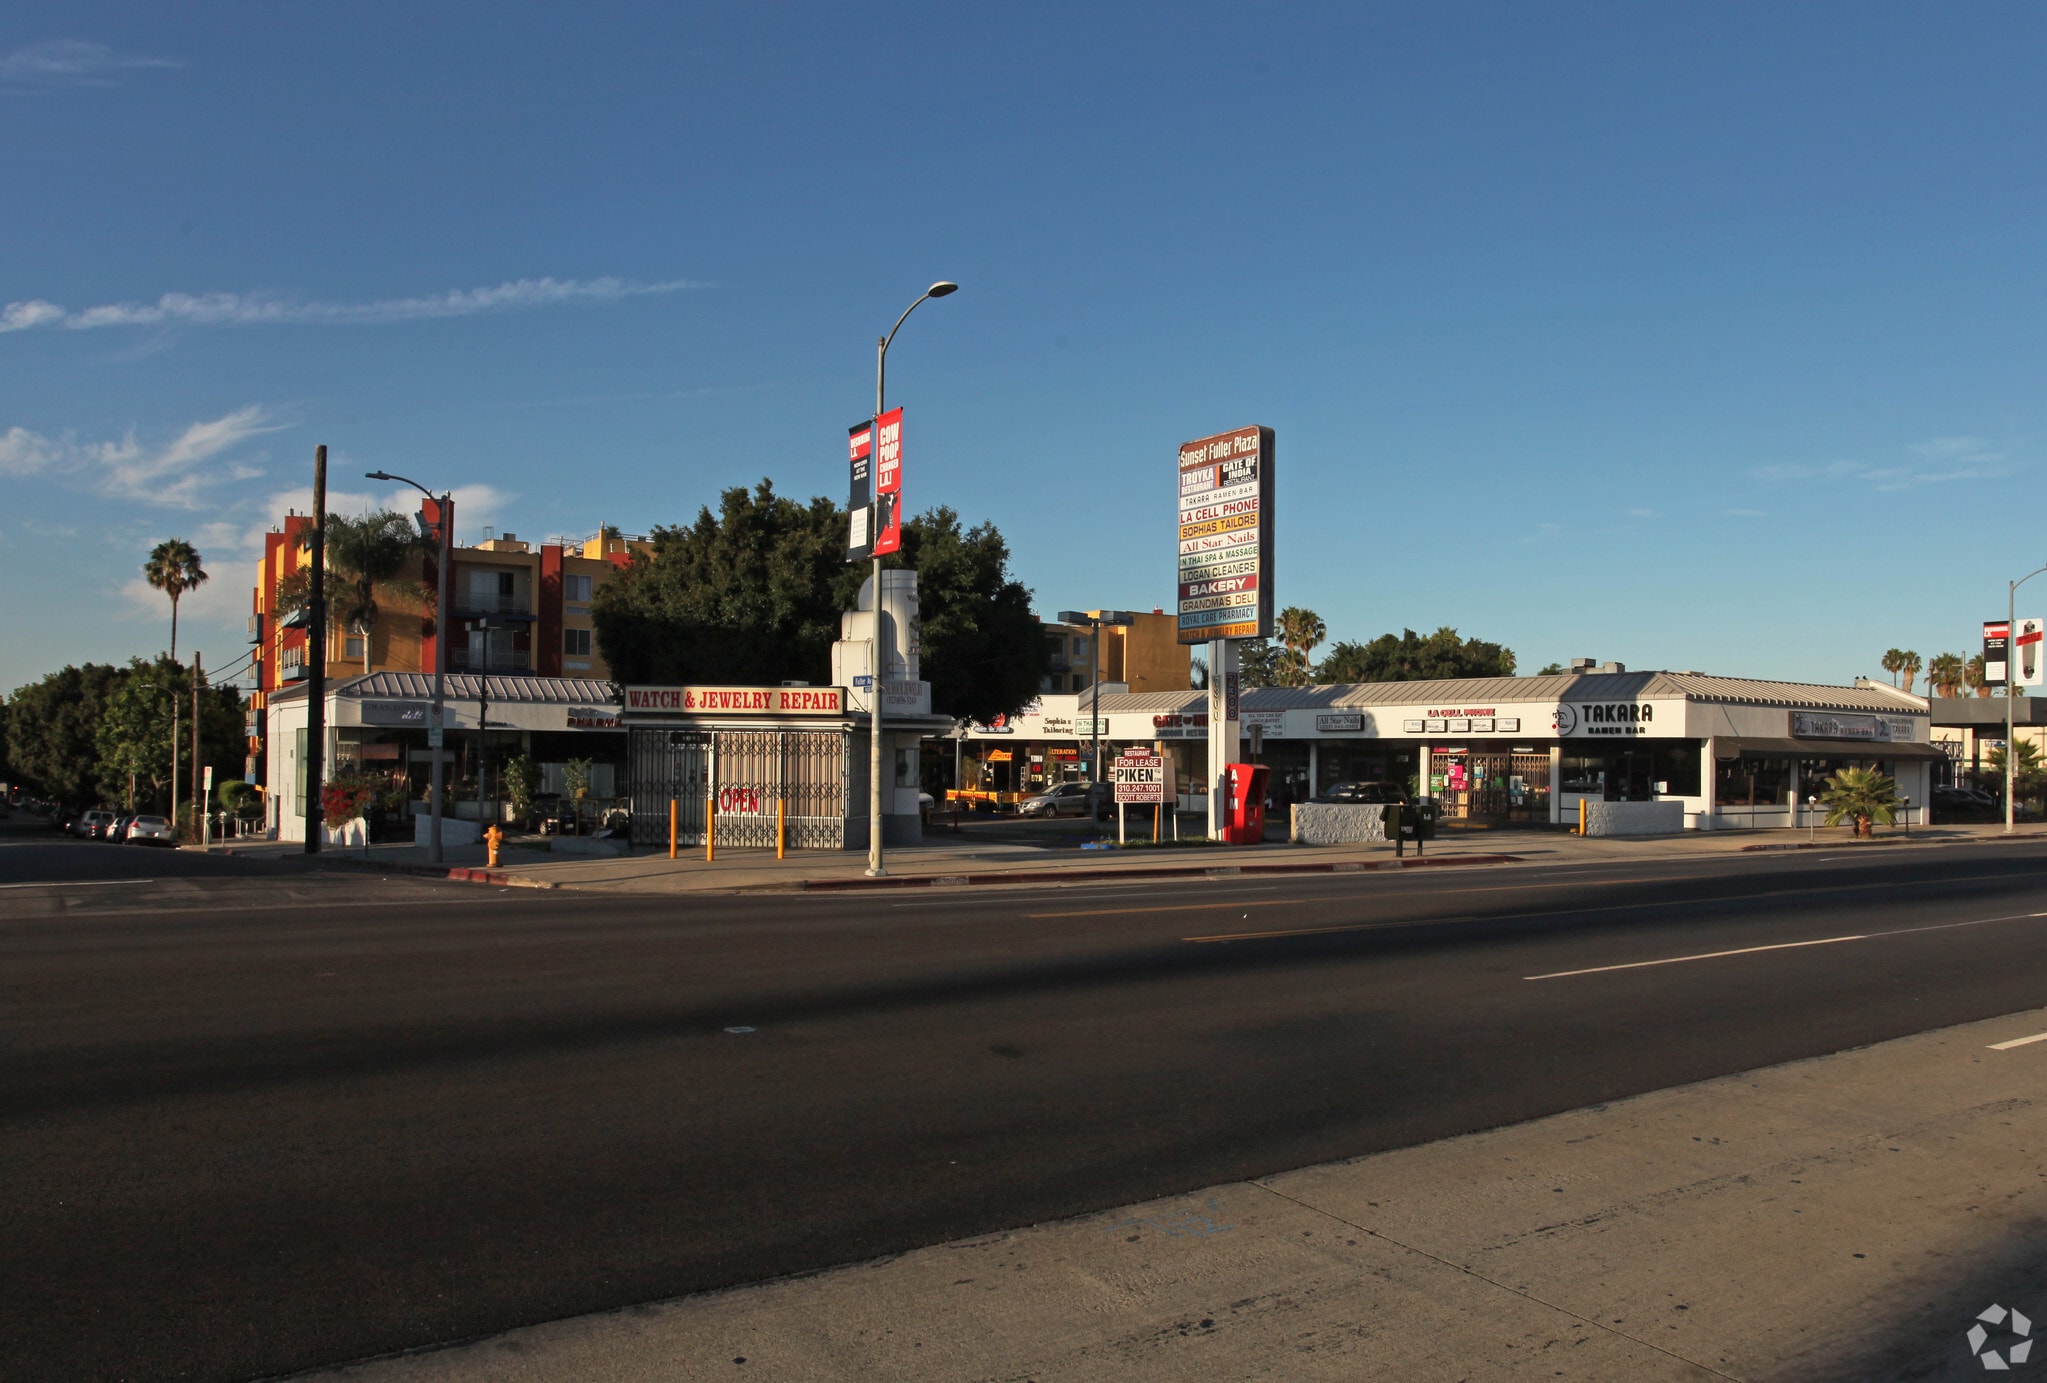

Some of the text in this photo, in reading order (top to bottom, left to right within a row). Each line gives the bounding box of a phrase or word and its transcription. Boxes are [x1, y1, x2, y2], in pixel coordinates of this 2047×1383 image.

[880, 422, 899, 445] COW
[880, 441, 899, 462] POOP
[1180, 433, 1257, 467] Sunset Fuller Plaza
[1222, 456, 1256, 473] GATE OF
[1228, 467, 1251, 479] INDIA
[1182, 467, 1213, 486] TROYKA
[1223, 474, 1255, 486] RESTAURANT
[1181, 480, 1213, 496] RESTAURANT
[1185, 486, 1253, 505] TAKARA RAMEN BAR
[1180, 499, 1258, 524] LA CELL PHONE
[1182, 515, 1256, 538] SOPHIAS TAILORS
[1183, 532, 1255, 553] All Star Nails
[1188, 555, 1203, 565] THAI
[1204, 553, 1217, 562] SPA
[1219, 551, 1223, 560] &
[1225, 546, 1258, 558] MASSAGE
[1183, 564, 1255, 582] LOGAN CLEANERS
[1189, 578, 1246, 596] BAKERY
[1235, 592, 1254, 604] DELI
[1181, 608, 1254, 626] ROYAL CARE PHARMACY
[1180, 629, 1200, 641] WATCH
[1234, 623, 1258, 635] REPAIR
[855, 677, 866, 685] Fuller
[629, 690, 839, 710] WATCH & JEWELRY REPAIR
[1228, 674, 1237, 720] 7300
[1153, 715, 1183, 728] GATE
[1320, 716, 1359, 724] All Star Nails
[1440, 708, 1462, 717] CELL
[1582, 704, 1652, 722] TAKARA
[1588, 727, 1621, 735] RAMEN
[1811, 720, 1838, 735] TAKARA
[1119, 759, 1159, 767] FOR LEASE
[1117, 769, 1153, 782] PIKEN
[1230, 769, 1239, 810] ATM
[721, 788, 758, 812] OPEN
